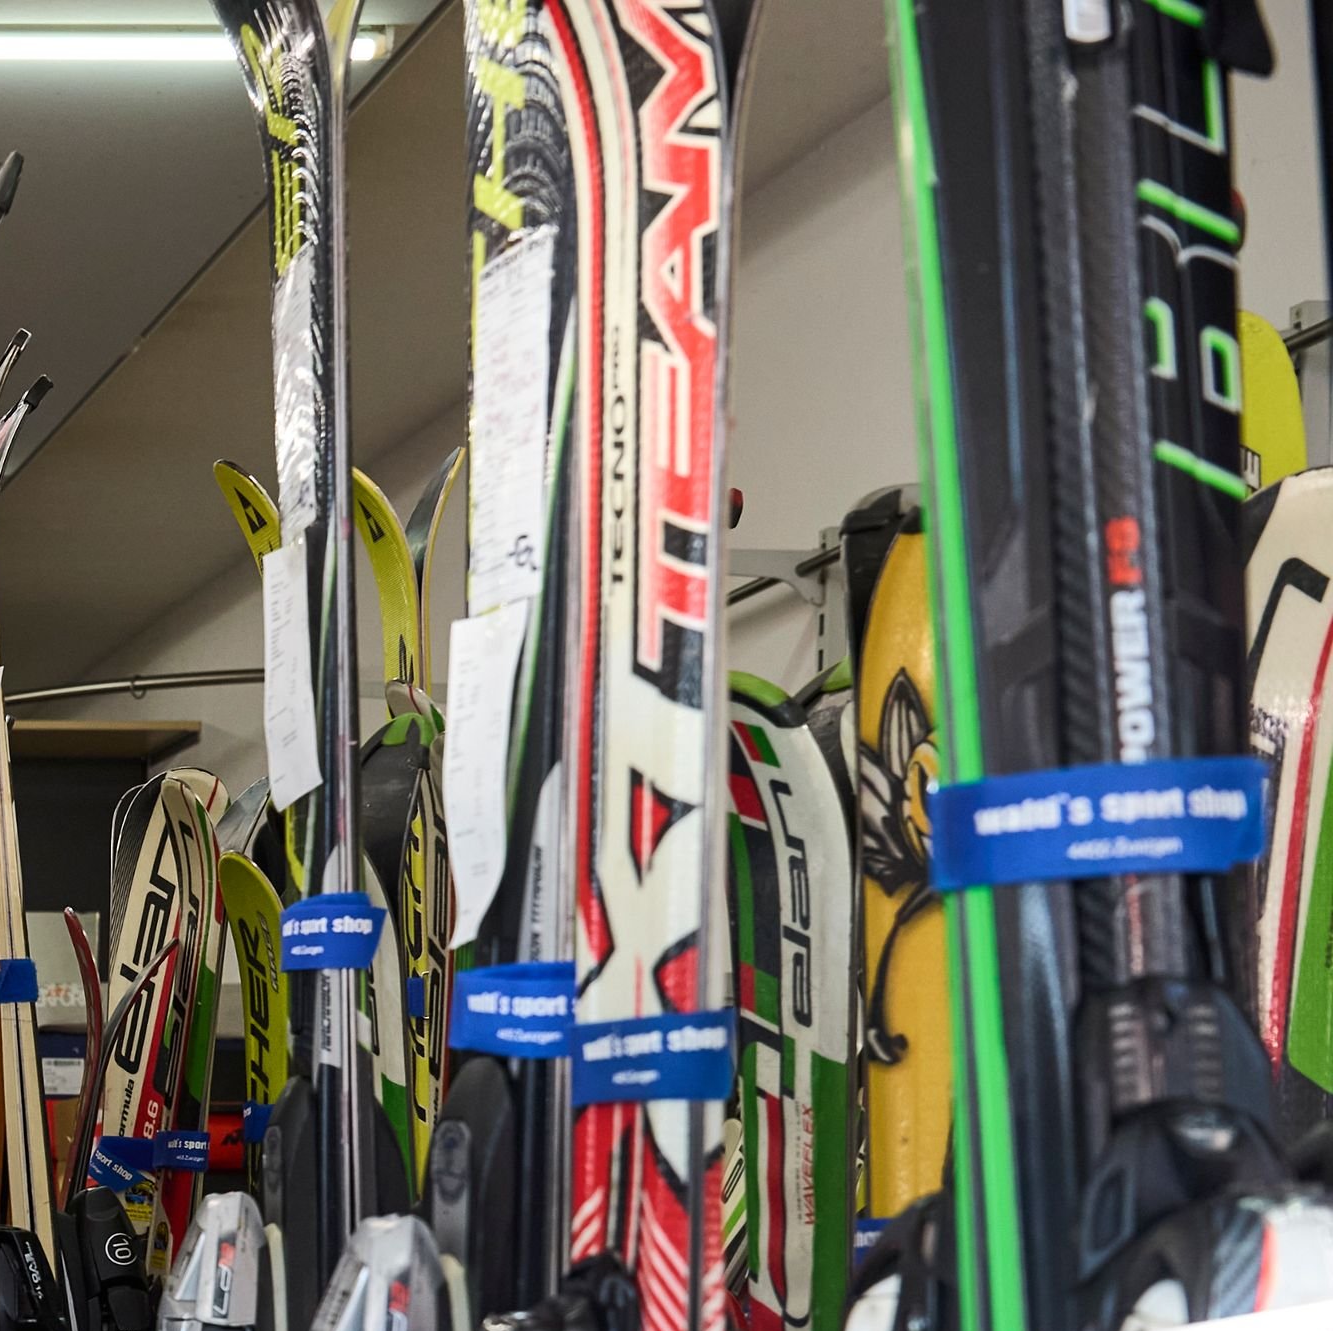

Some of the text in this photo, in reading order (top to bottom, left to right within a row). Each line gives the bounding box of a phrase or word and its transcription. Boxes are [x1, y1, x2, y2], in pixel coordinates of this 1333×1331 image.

[331, 916, 373, 935] shop
[769, 778, 813, 1029] elan
[238, 917, 271, 1105] CHER
[118, 1079, 159, 1139] ormula 8.6
[804, 1102, 816, 1228] WAVEFLEX
